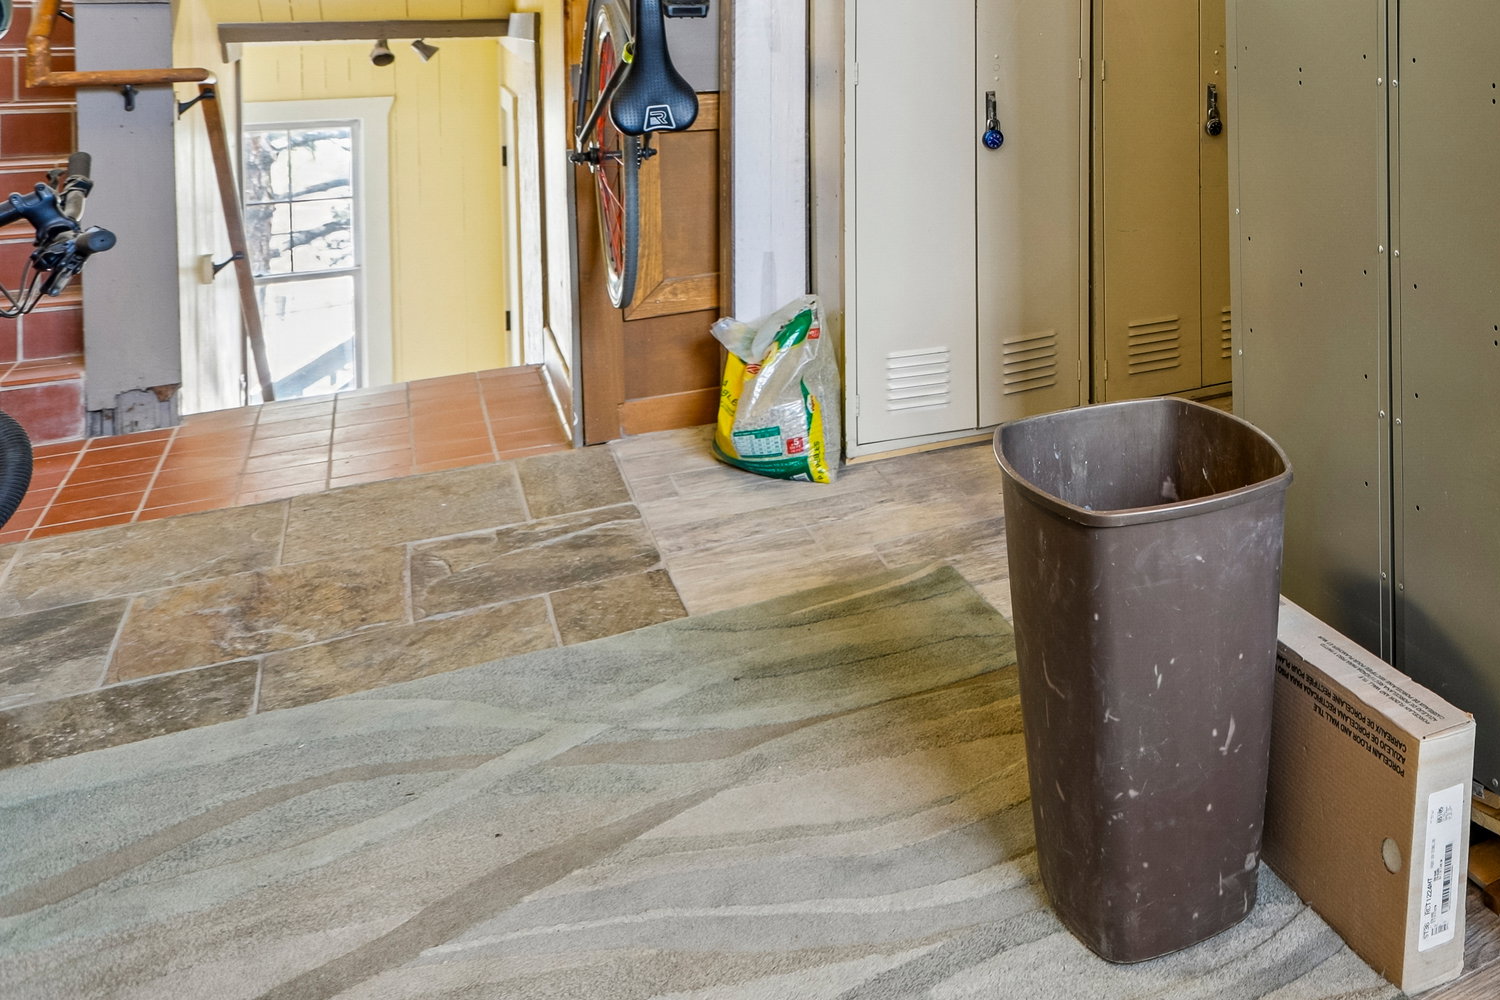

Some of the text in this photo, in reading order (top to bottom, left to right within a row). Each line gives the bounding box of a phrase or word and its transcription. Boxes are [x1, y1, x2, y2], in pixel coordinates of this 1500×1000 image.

[1290, 674, 1303, 690] PARA
[1291, 663, 1306, 680] POUR
[1304, 684, 1337, 714] RECTIFICADA
[1332, 692, 1366, 724] PORCELAINE
[1337, 708, 1371, 739] PORCELANA
[1367, 717, 1376, 730] DE
[1313, 703, 1405, 778] PORCELAIN FLOOR AND WALL TILE
[1371, 732, 1380, 746] DE
[1375, 724, 1407, 753] CARREAUX
[1380, 740, 1406, 765] AZULEJO
